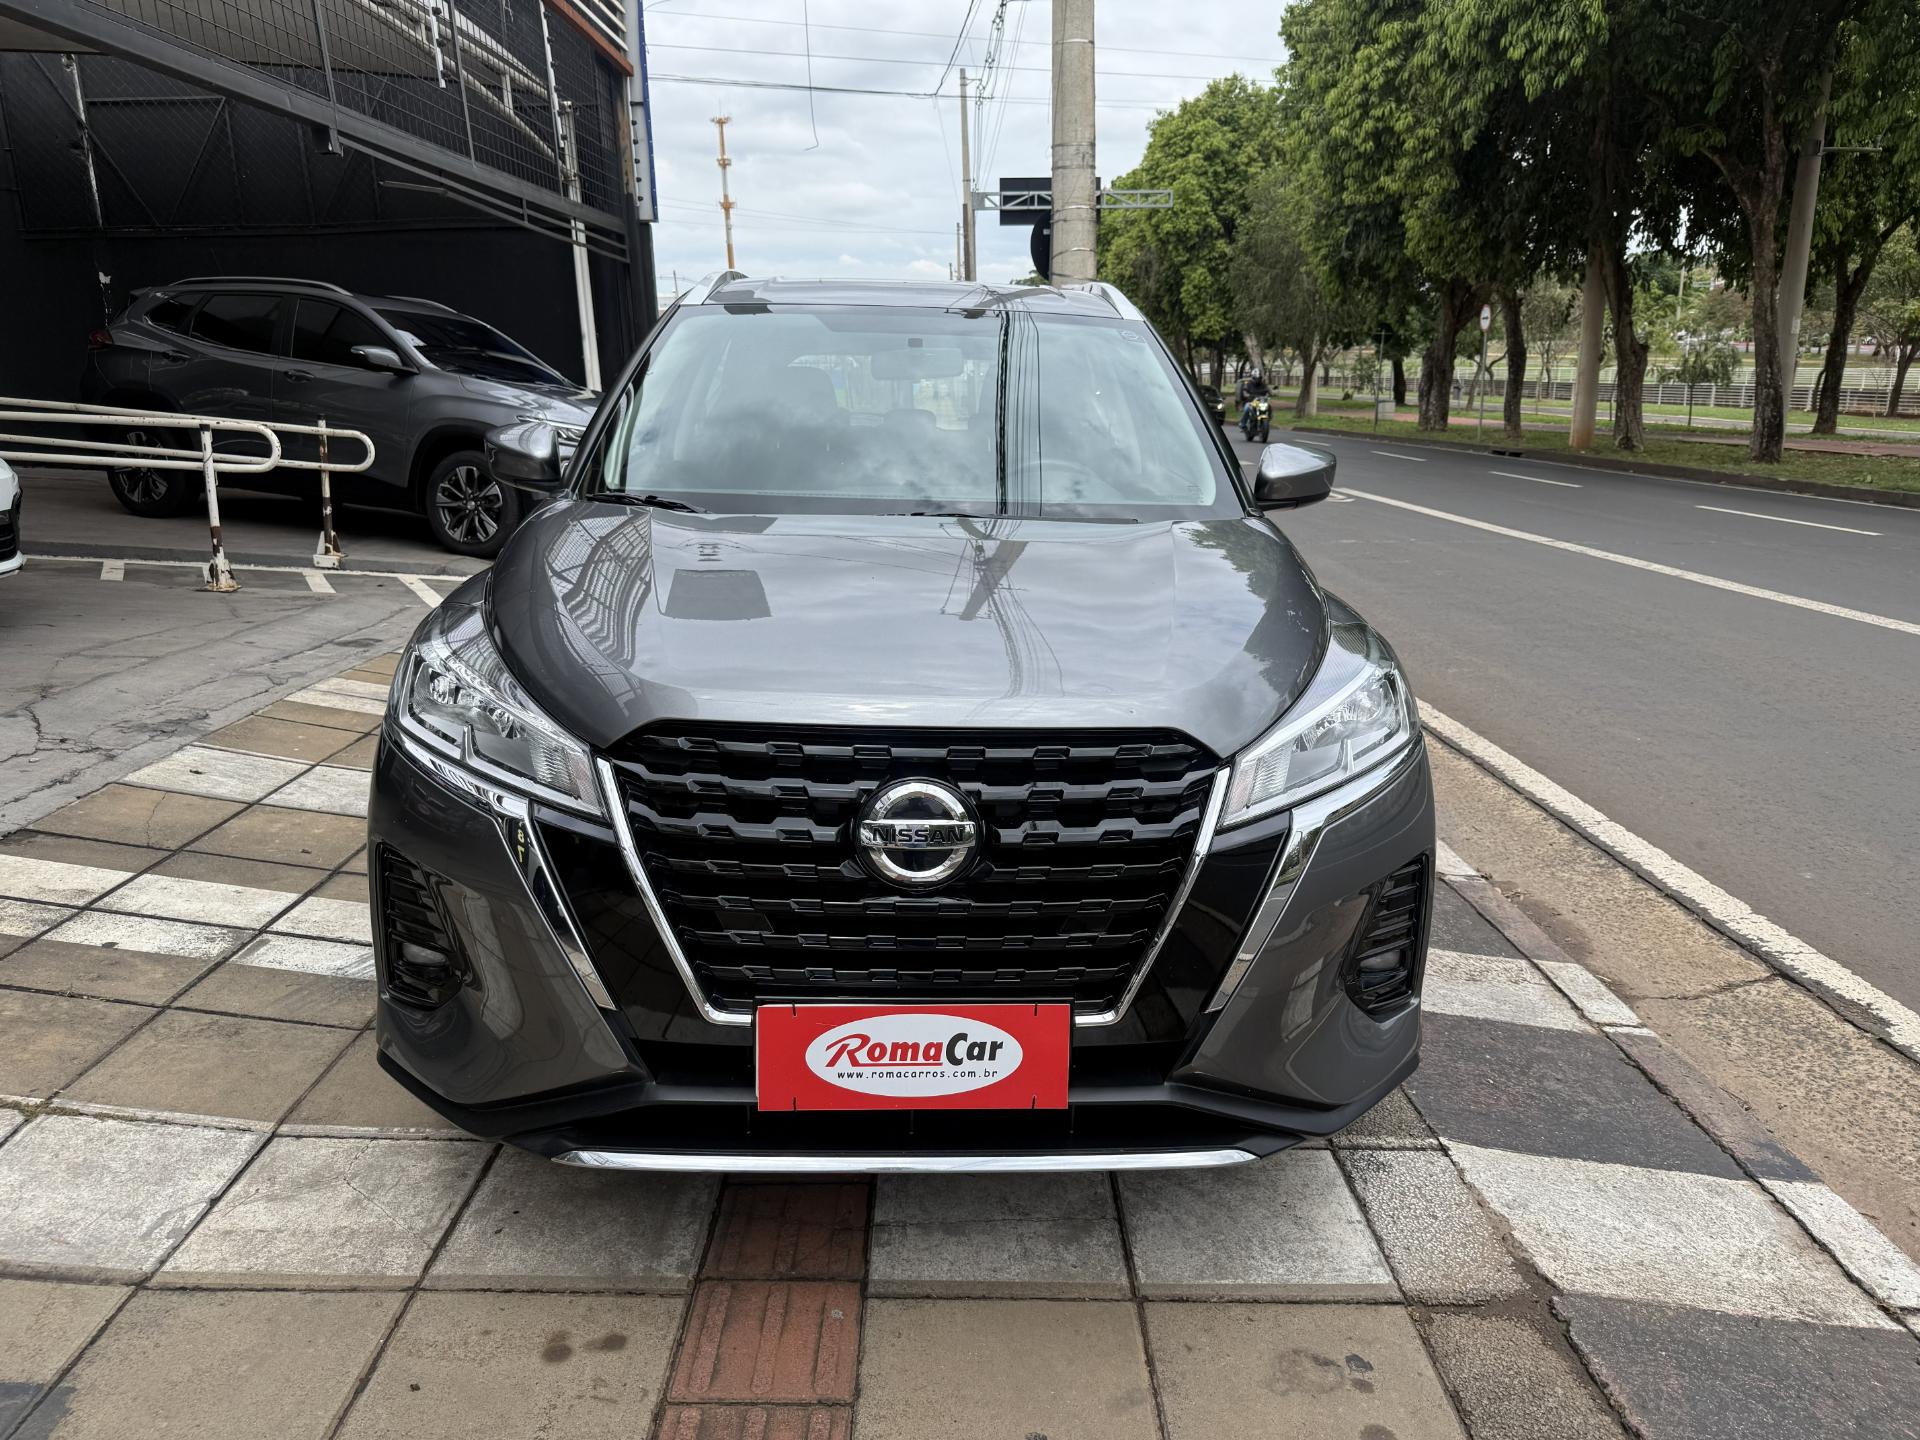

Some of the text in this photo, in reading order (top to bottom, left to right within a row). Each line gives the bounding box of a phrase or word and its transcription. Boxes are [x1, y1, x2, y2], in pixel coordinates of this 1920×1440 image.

[871, 826, 966, 844] NISSAN
[825, 1032, 1004, 1067] RomaCar
[837, 1068, 998, 1079] www.romacarros.com.br
